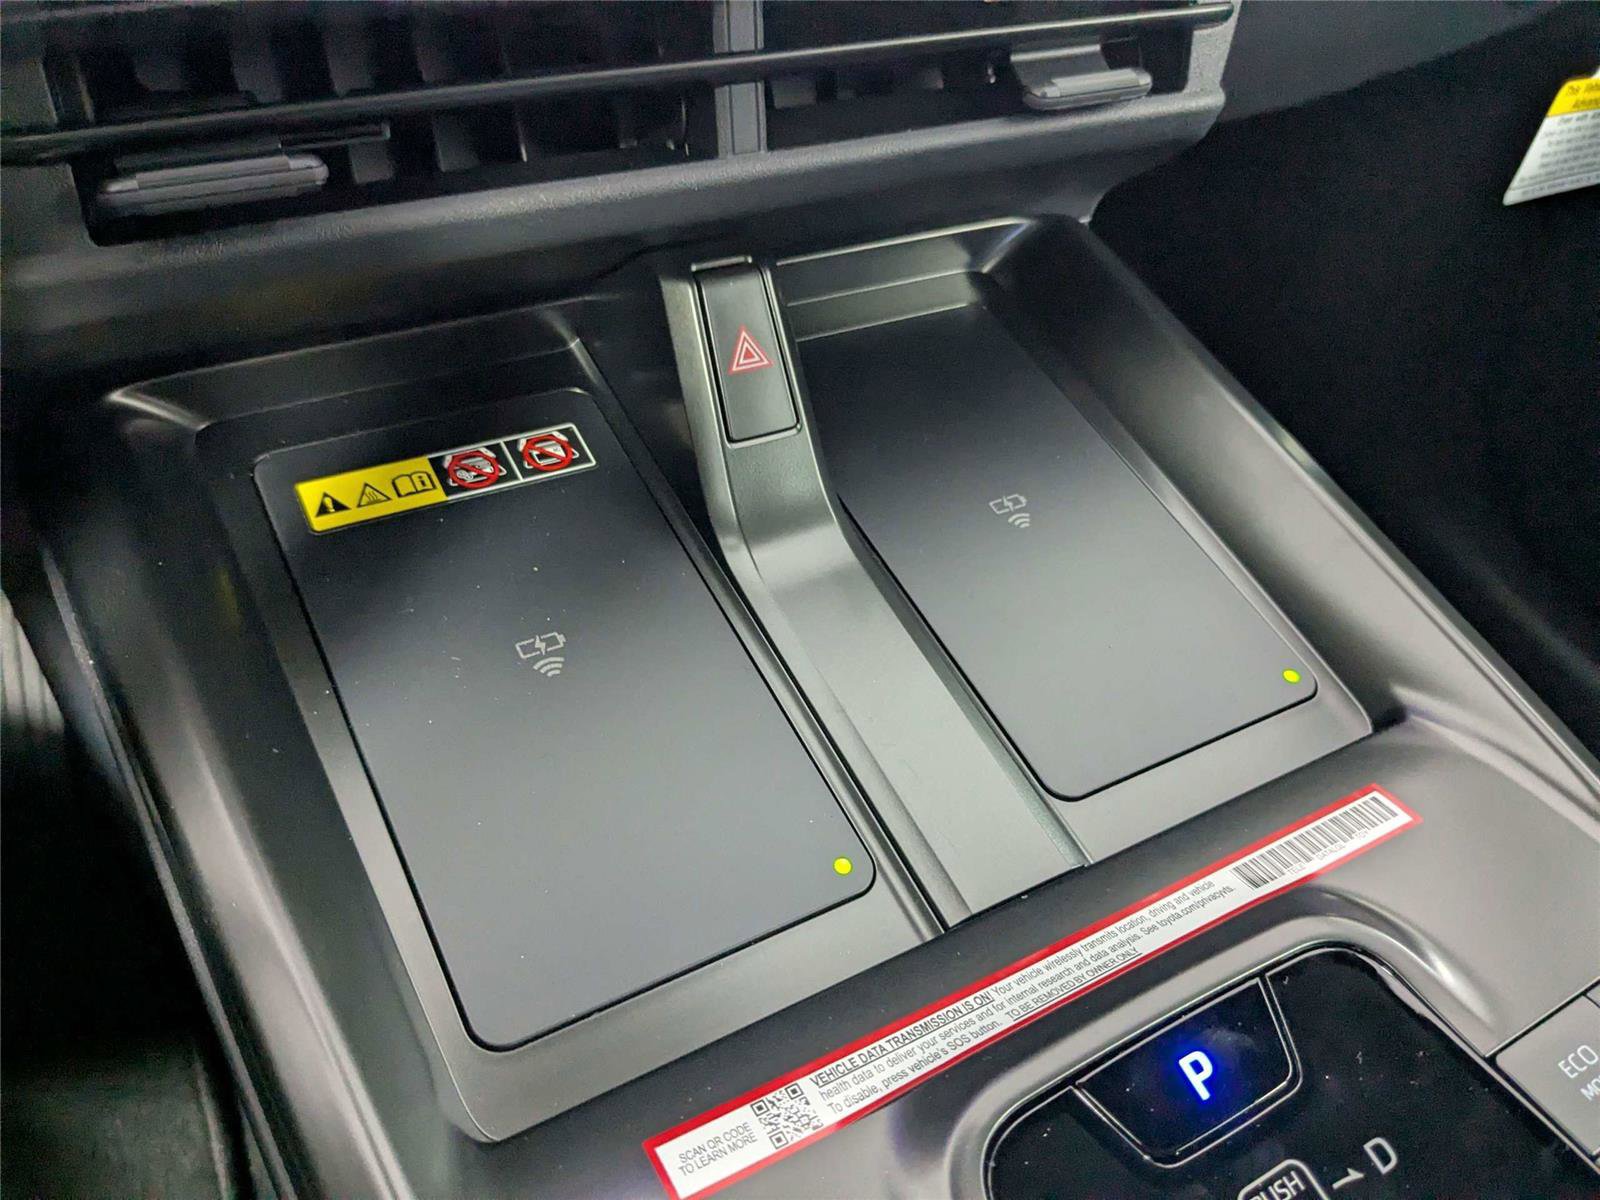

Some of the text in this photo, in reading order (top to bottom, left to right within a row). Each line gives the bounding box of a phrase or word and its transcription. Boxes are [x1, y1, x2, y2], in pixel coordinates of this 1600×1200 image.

[809, 1053, 859, 1087] VEHICLE
[859, 1044, 886, 1065] DATA
[885, 1006, 963, 1049] TRANSMISSION
[962, 1000, 975, 1015] IS
[974, 993, 993, 1008] ON!
[991, 982, 1013, 999] Your
[1014, 966, 1044, 987] vehicle
[1043, 948, 1083, 971] wirelessly
[1080, 930, 1119, 951] transmits
[1148, 901, 1177, 918] driving
[1175, 892, 1190, 906] and
[1187, 880, 1215, 897] vehicle
[1005, 946, 1139, 1021] TO BE REMOVED BY OWNER ONLY
[818, 1079, 852, 1102] health
[851, 1069, 874, 1086] data
[874, 1061, 886, 1075] to
[886, 1046, 918, 1068] deliver
[918, 1036, 938, 1055] your
[938, 1016, 976, 1040] services
[977, 1007, 993, 1021] and
[991, 1000, 1007, 1014] for
[1006, 983, 1040, 1006] internal
[1038, 967, 1075, 989] research
[1074, 957, 1091, 972] and
[1089, 948, 1109, 964] data
[1107, 933, 1143, 953] analysis.
[1140, 923, 1159, 935] See
[827, 1019, 1003, 1115] To disable, press vehicle's SOS button.
[1178, 1050, 1213, 1101] P
[1558, 1044, 1599, 1078] ECO
[1580, 1075, 1600, 1101] MO
[678, 1122, 752, 1164] SCAN QR CODE
[678, 1132, 758, 1176] TO LEARN MORE
[1363, 1136, 1398, 1175] D
[1249, 1170, 1306, 1200] USH
